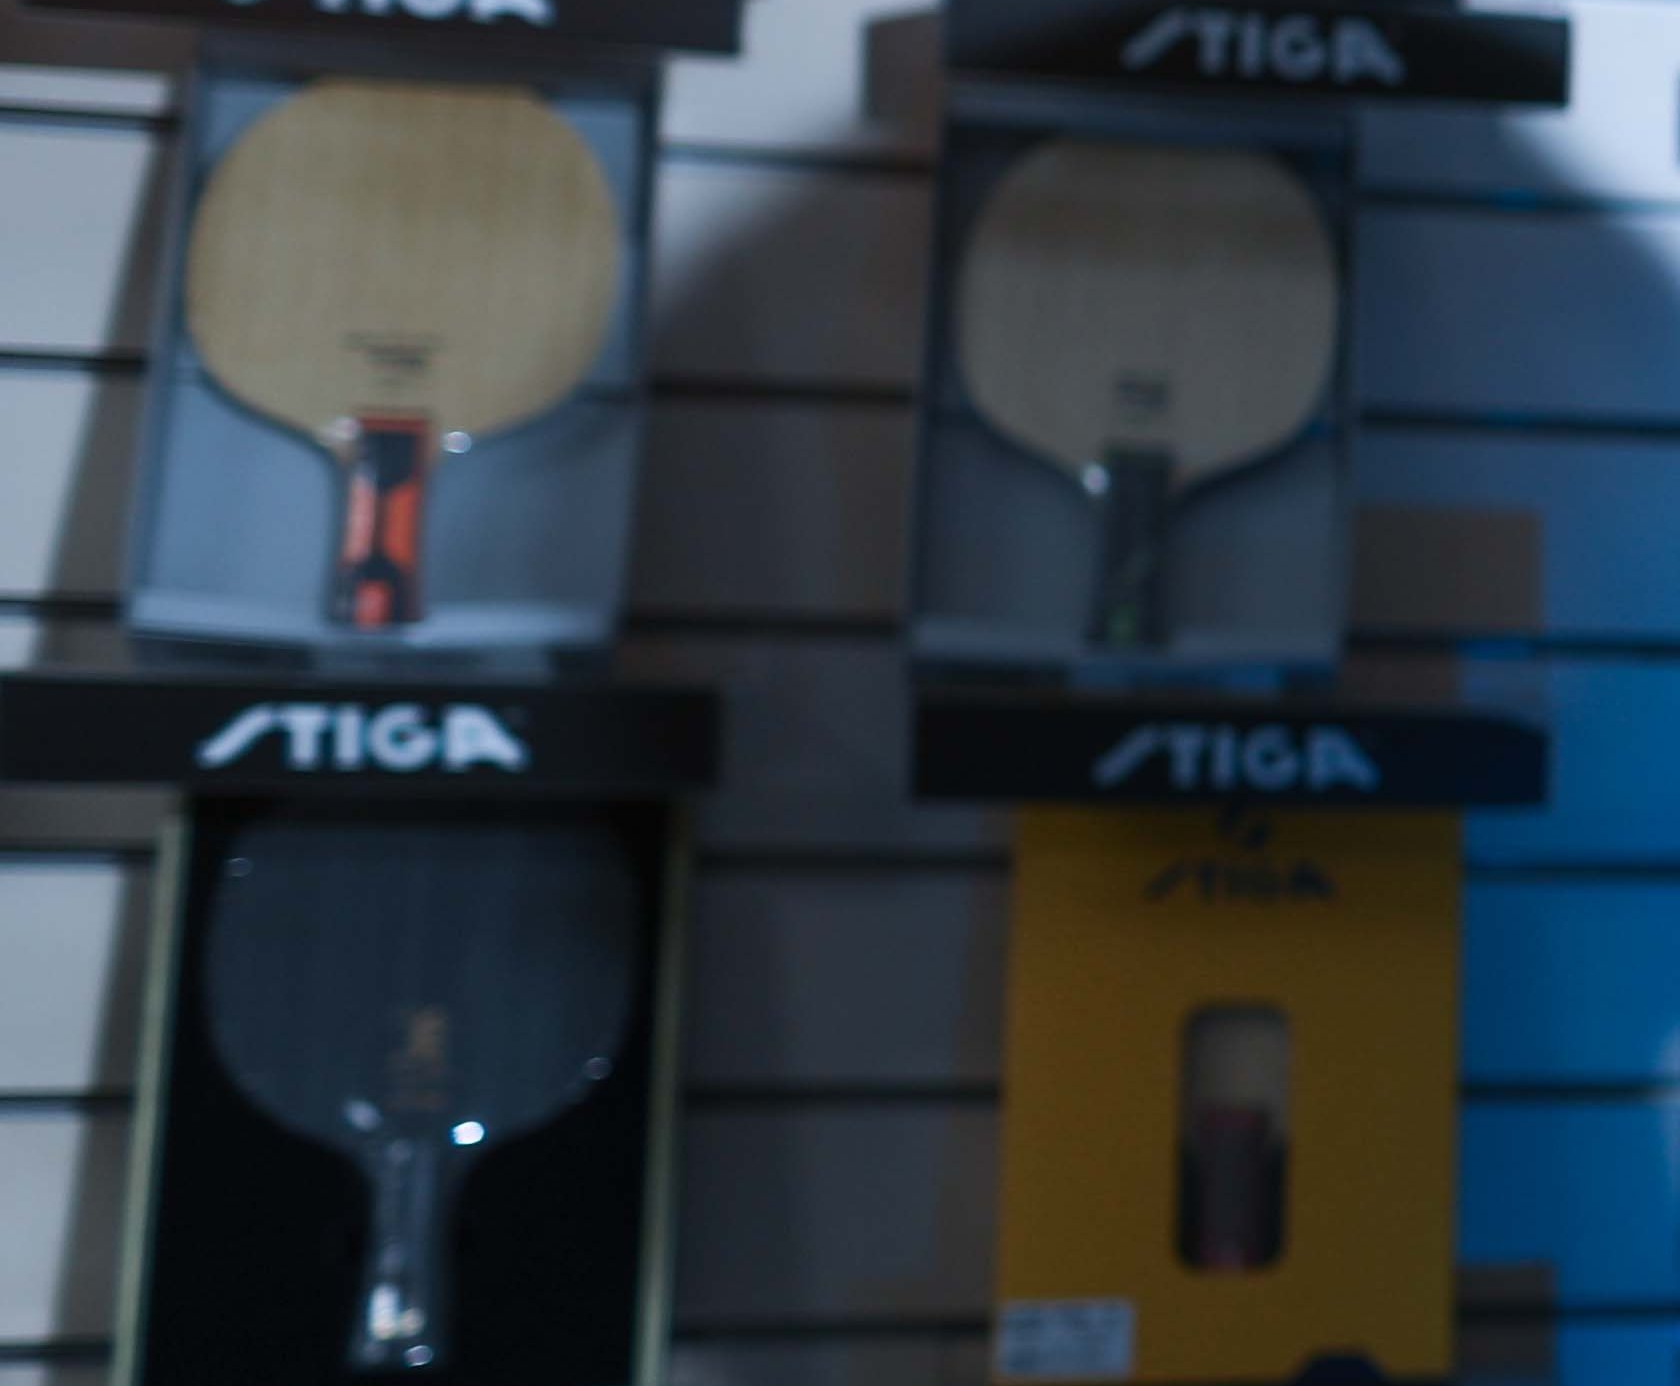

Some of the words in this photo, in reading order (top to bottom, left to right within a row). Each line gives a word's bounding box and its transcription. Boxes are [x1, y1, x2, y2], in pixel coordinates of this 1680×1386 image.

[1122, 6, 1405, 85] STIGA
[198, 702, 528, 771] STIGA
[1092, 723, 1380, 791] STIGA
